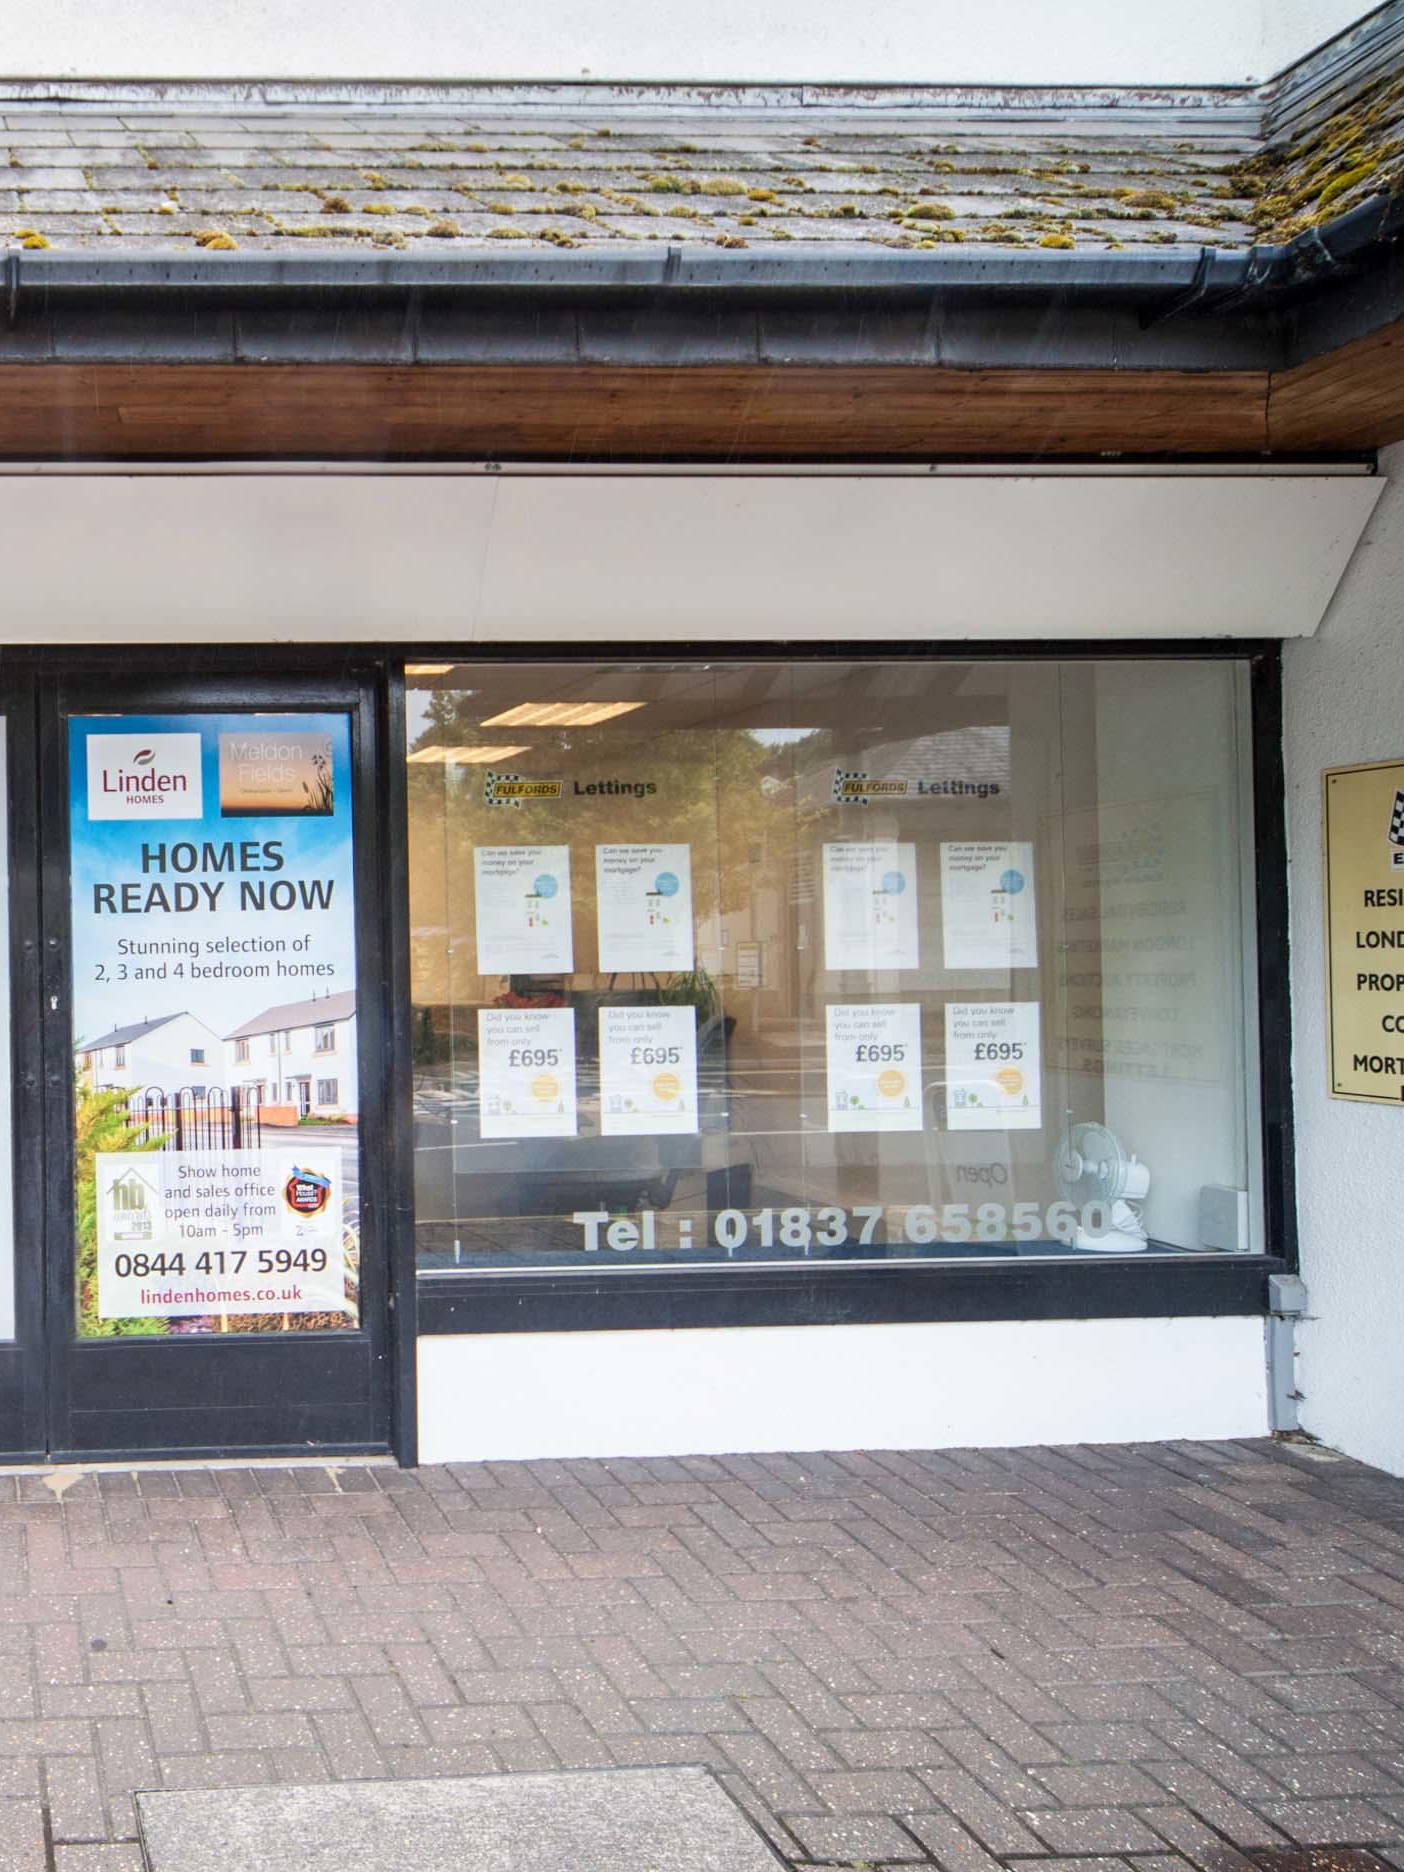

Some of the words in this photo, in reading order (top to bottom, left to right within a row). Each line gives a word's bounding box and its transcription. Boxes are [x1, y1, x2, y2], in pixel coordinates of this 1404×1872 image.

[229, 742, 303, 761] Meldon
[102, 768, 187, 793] Linden
[237, 763, 296, 785] Fields
[496, 785, 557, 795] FULFORDS
[572, 780, 658, 798] Lettings
[844, 782, 904, 794] FULFORDS
[917, 779, 1001, 799] Lettings
[126, 795, 164, 805] HOMES
[140, 840, 285, 874] HOMES
[92, 881, 225, 914] READY
[239, 879, 335, 912] NOW
[1363, 888, 1404, 908] RESI
[117, 938, 200, 958] Stunning
[205, 936, 286, 954] selection
[292, 934, 312, 952] of
[94, 964, 110, 983] 2,
[117, 963, 129, 980] 3
[134, 962, 167, 980] and
[173, 962, 185, 979] 4
[190, 962, 270, 979] bedroom
[276, 960, 335, 977] homes
[508, 1048, 559, 1067] £695
[630, 1047, 681, 1065] £695
[855, 1044, 906, 1062] £695
[974, 1042, 1024, 1060] £695
[177, 1164, 218, 1179] Show
[221, 1164, 262, 1178] home
[164, 1185, 192, 1199] and
[195, 1184, 231, 1198] sales
[235, 1183, 276, 1197] office
[164, 1207, 200, 1221] open
[204, 1204, 239, 1219] daily
[242, 1203, 277, 1217] from
[179, 1223, 217, 1238] 10am
[232, 1223, 264, 1240] 5pm
[573, 1210, 655, 1252] Tel
[714, 1206, 883, 1250] 01837
[904, 1201, 1111, 1243] 658560
[114, 1252, 186, 1278] 0844
[194, 1250, 248, 1276] 417
[257, 1248, 328, 1274] 5949
[140, 1284, 304, 1305] lindenhomes.co.uk
